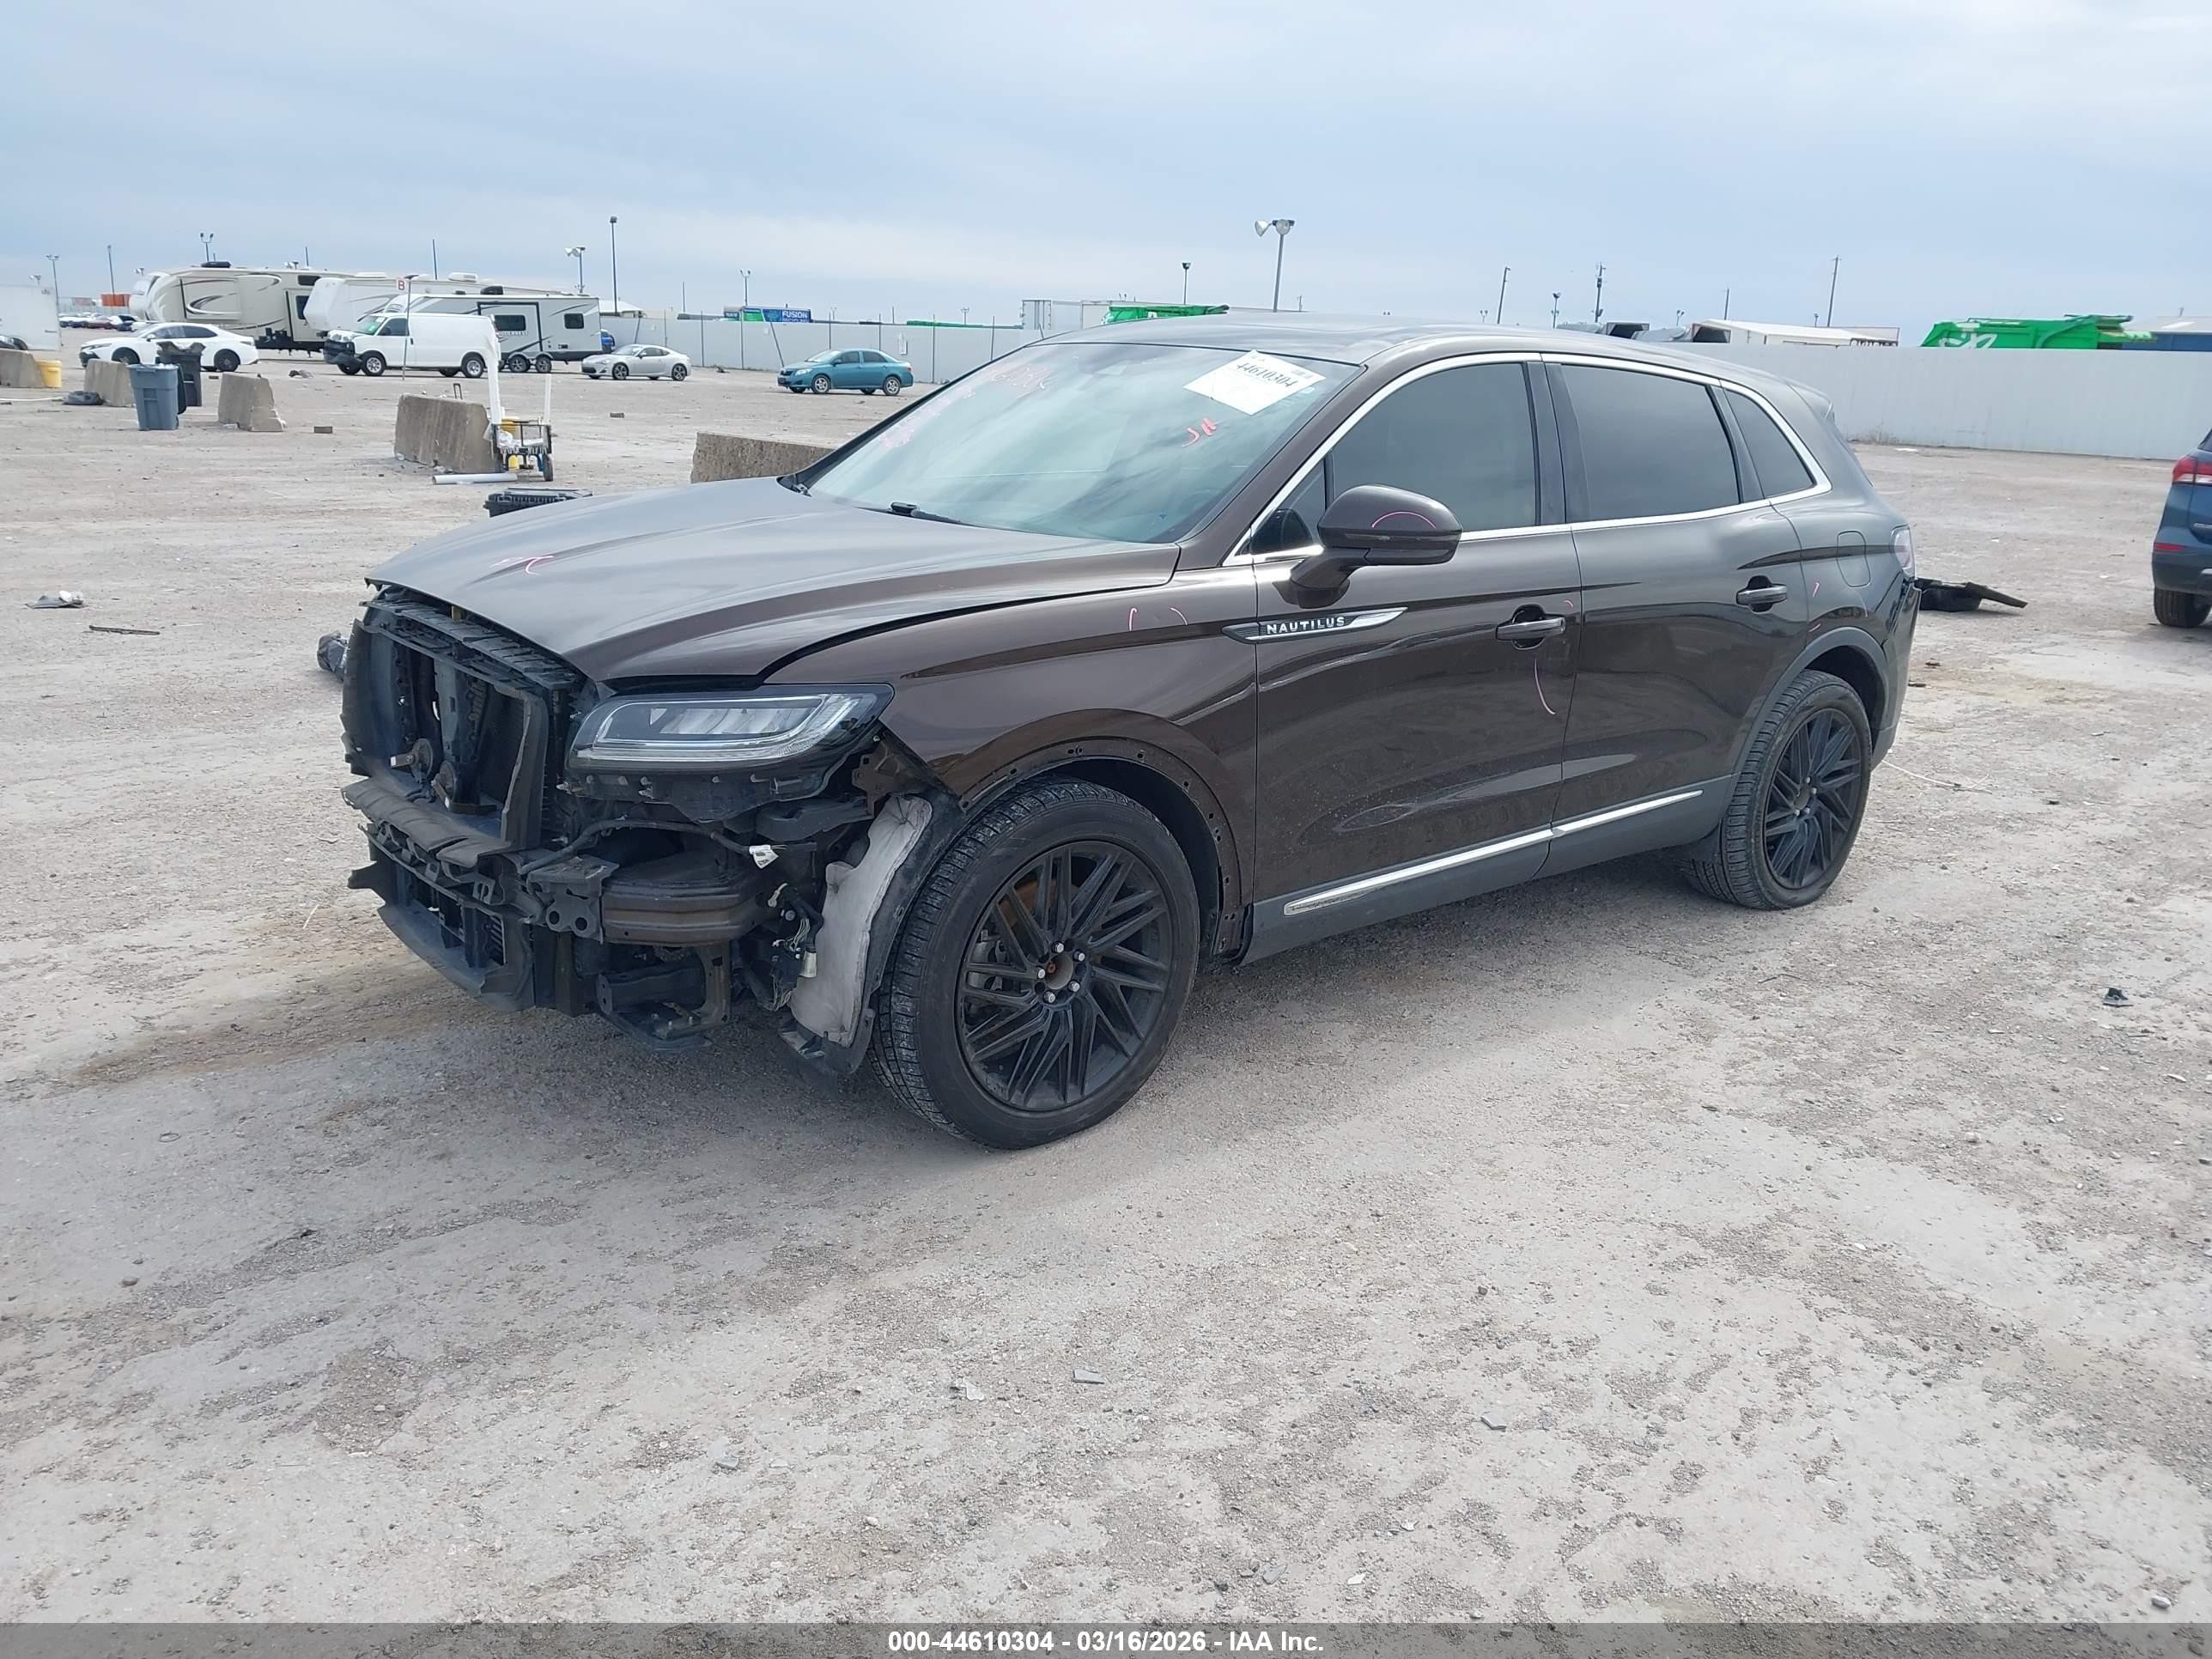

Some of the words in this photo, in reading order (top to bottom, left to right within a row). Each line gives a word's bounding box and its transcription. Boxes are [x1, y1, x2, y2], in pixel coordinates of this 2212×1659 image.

[398, 280, 405, 290] B
[782, 310, 808, 319] FUSION
[1237, 362, 1299, 387] 44610304
[1267, 617, 1346, 635] NAUTILUS
